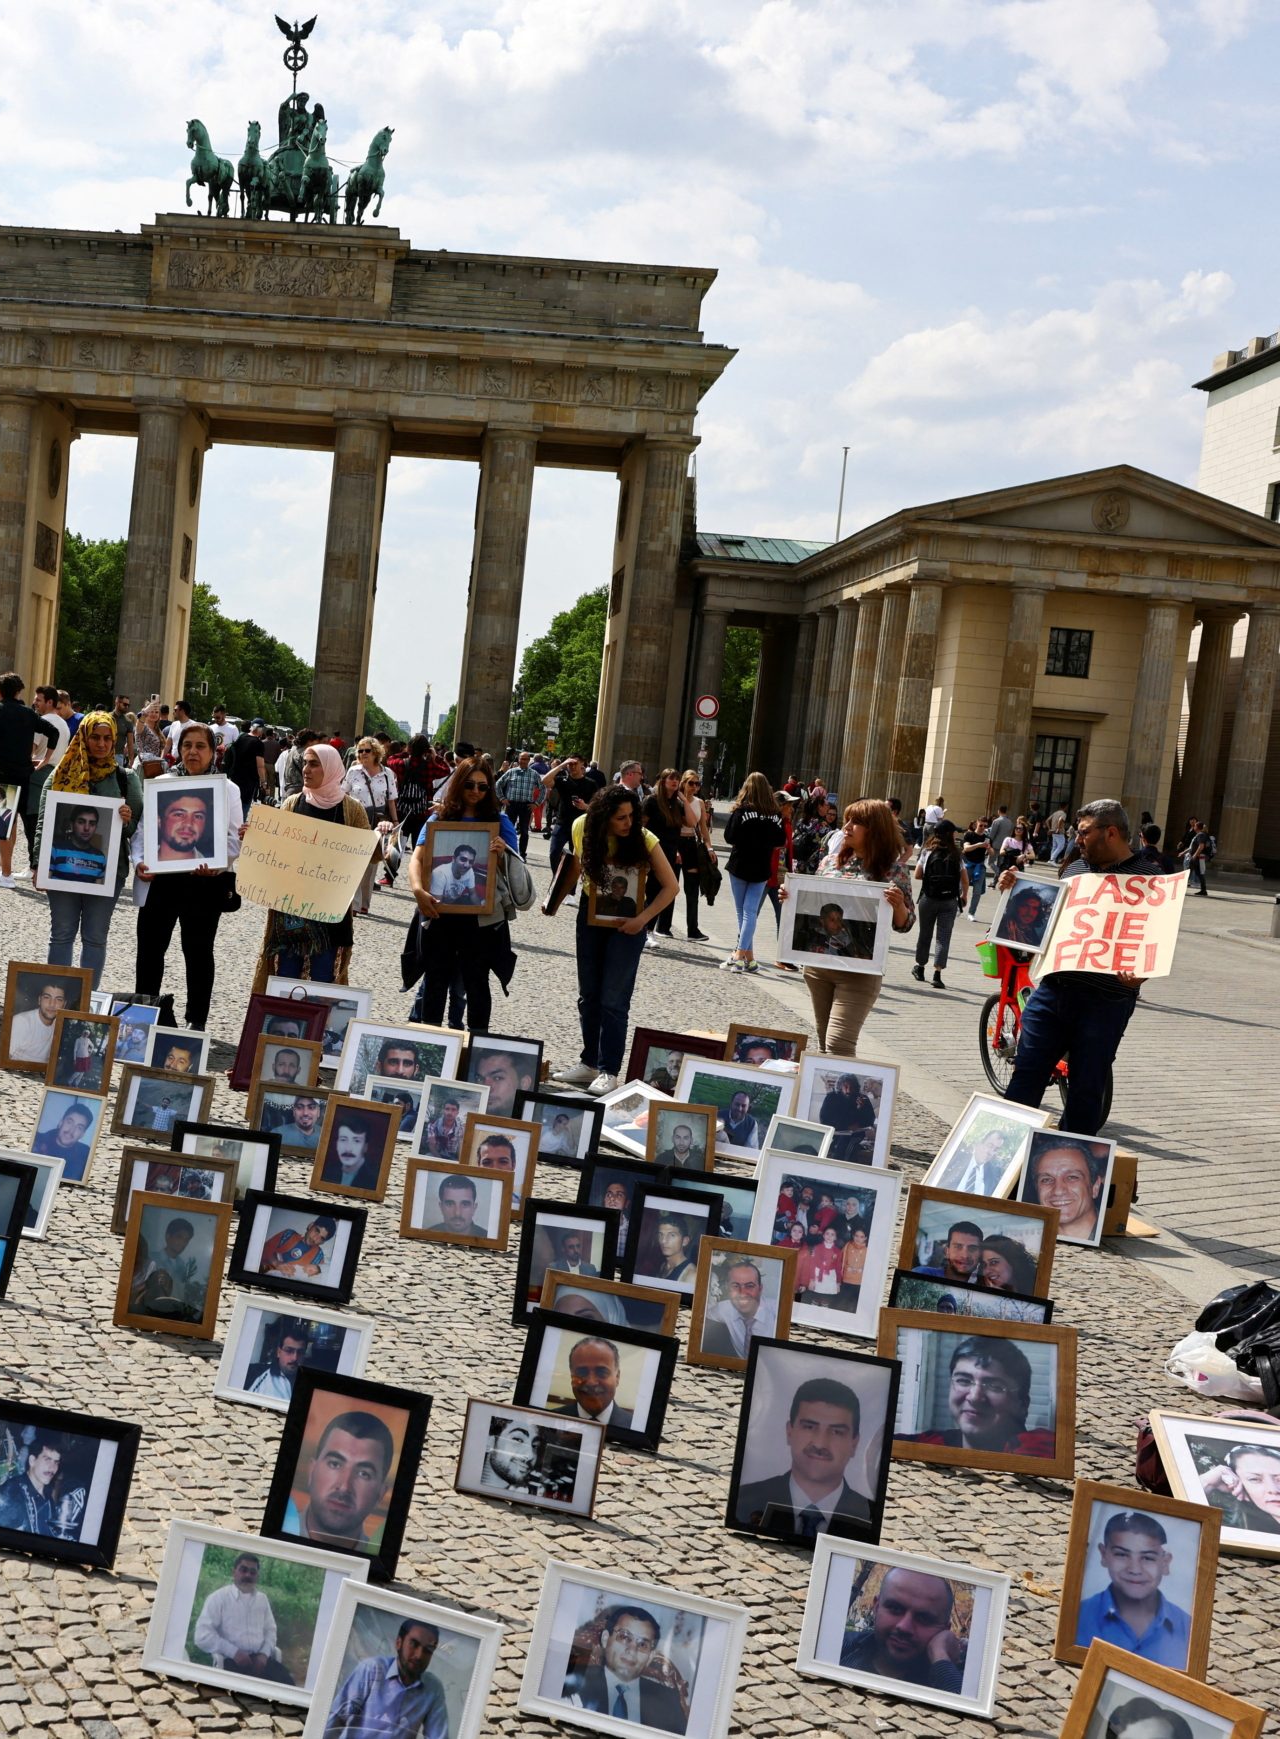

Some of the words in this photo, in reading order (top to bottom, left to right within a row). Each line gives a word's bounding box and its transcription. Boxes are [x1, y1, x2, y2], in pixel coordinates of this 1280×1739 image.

[297, 861, 351, 885] dictators
[1065, 873, 1186, 909] LASST
[1069, 908, 1150, 941] SIE
[1053, 938, 1158, 973] FREI
